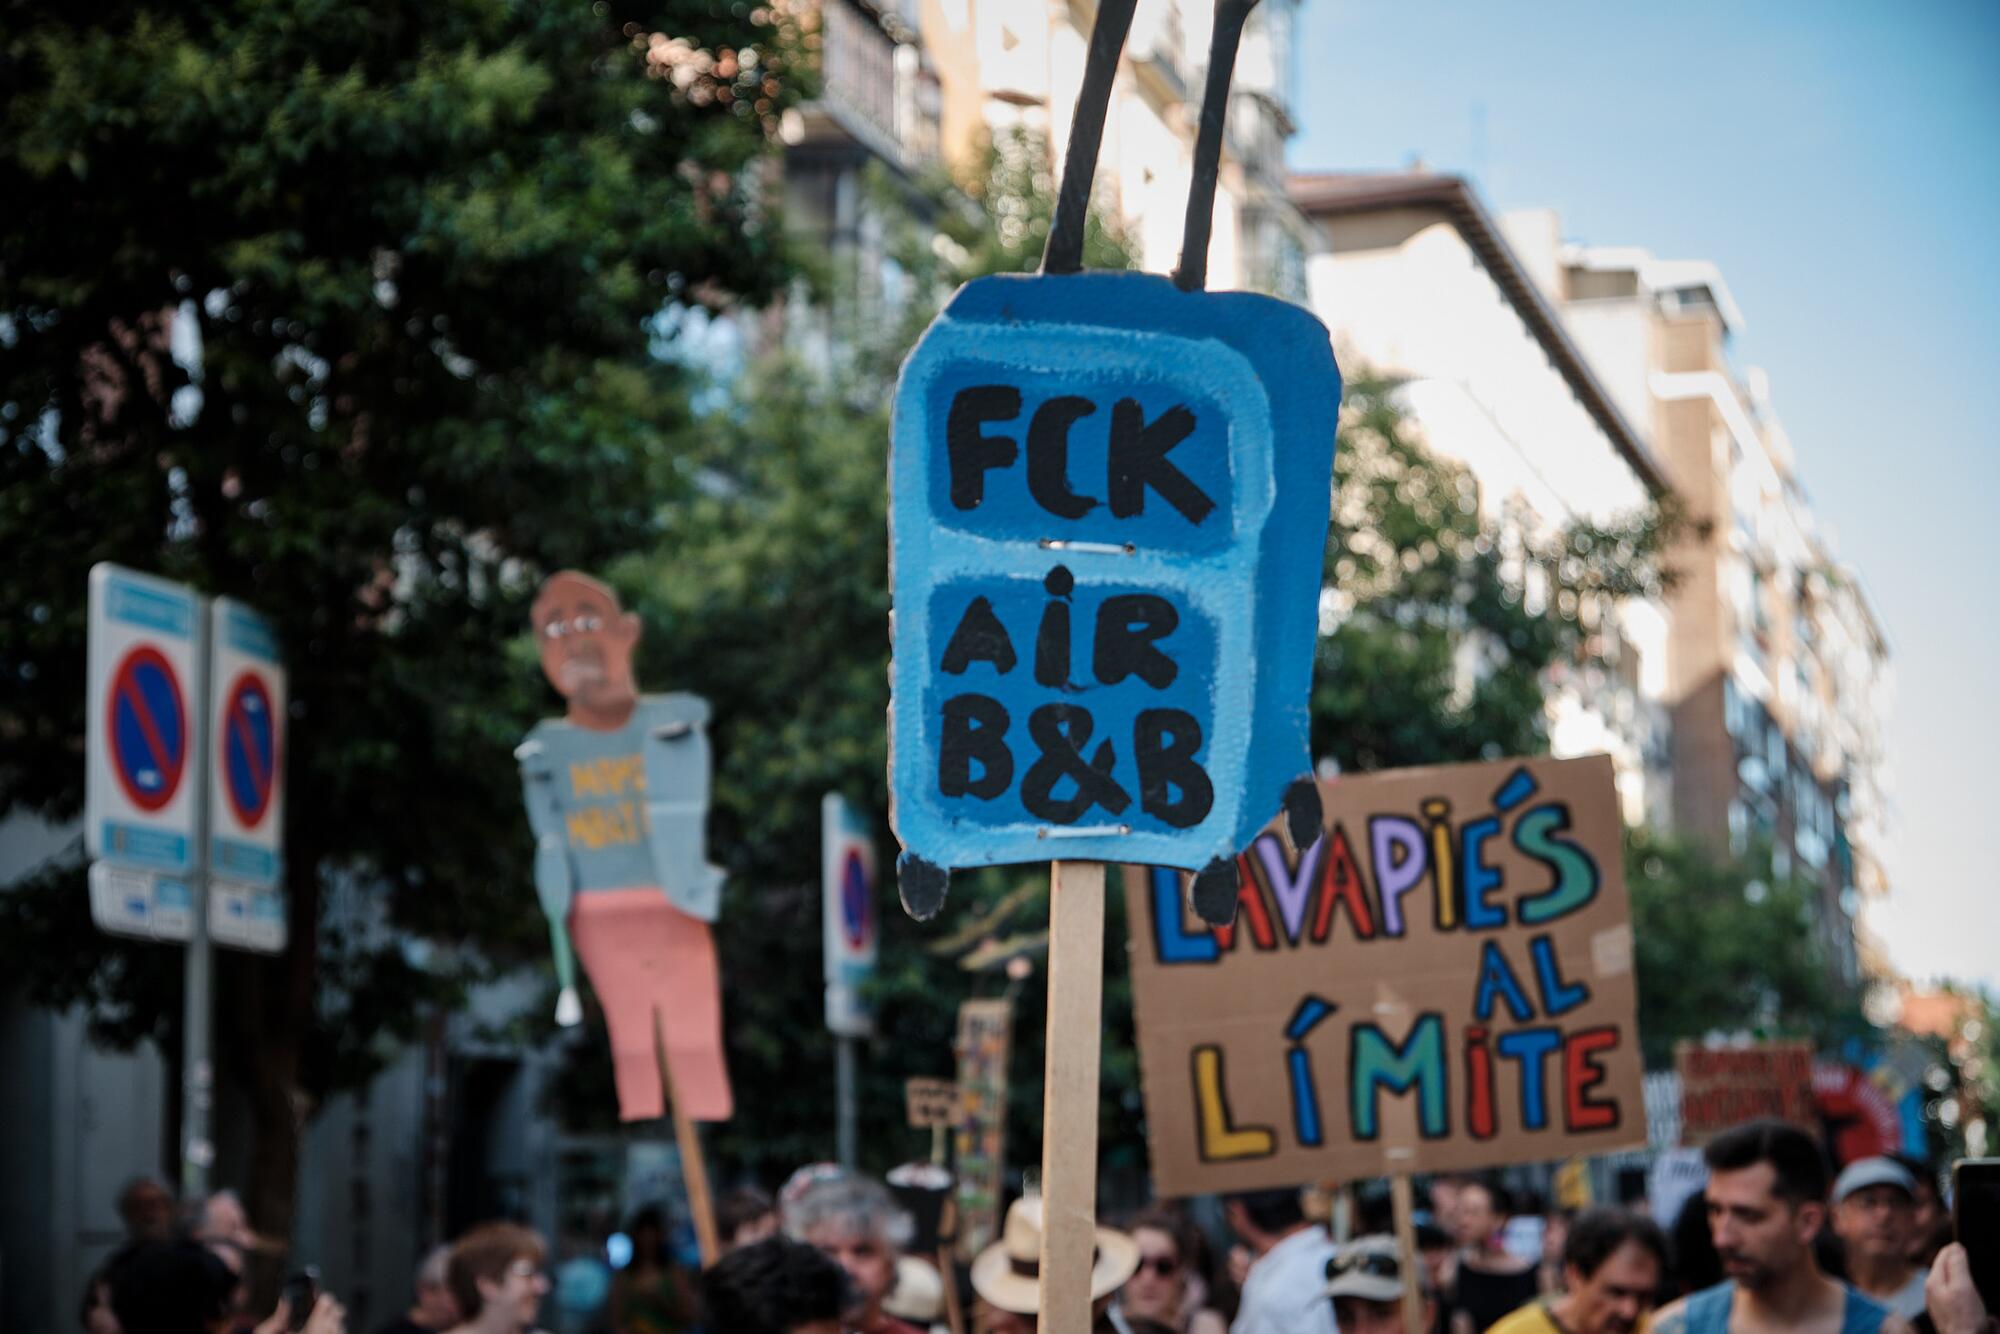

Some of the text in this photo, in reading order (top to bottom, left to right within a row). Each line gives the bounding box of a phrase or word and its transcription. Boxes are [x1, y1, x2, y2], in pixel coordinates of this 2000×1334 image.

[946, 385, 1217, 526] FCK
[938, 693, 1214, 828] B&B
[1474, 934, 1591, 1022] AL
